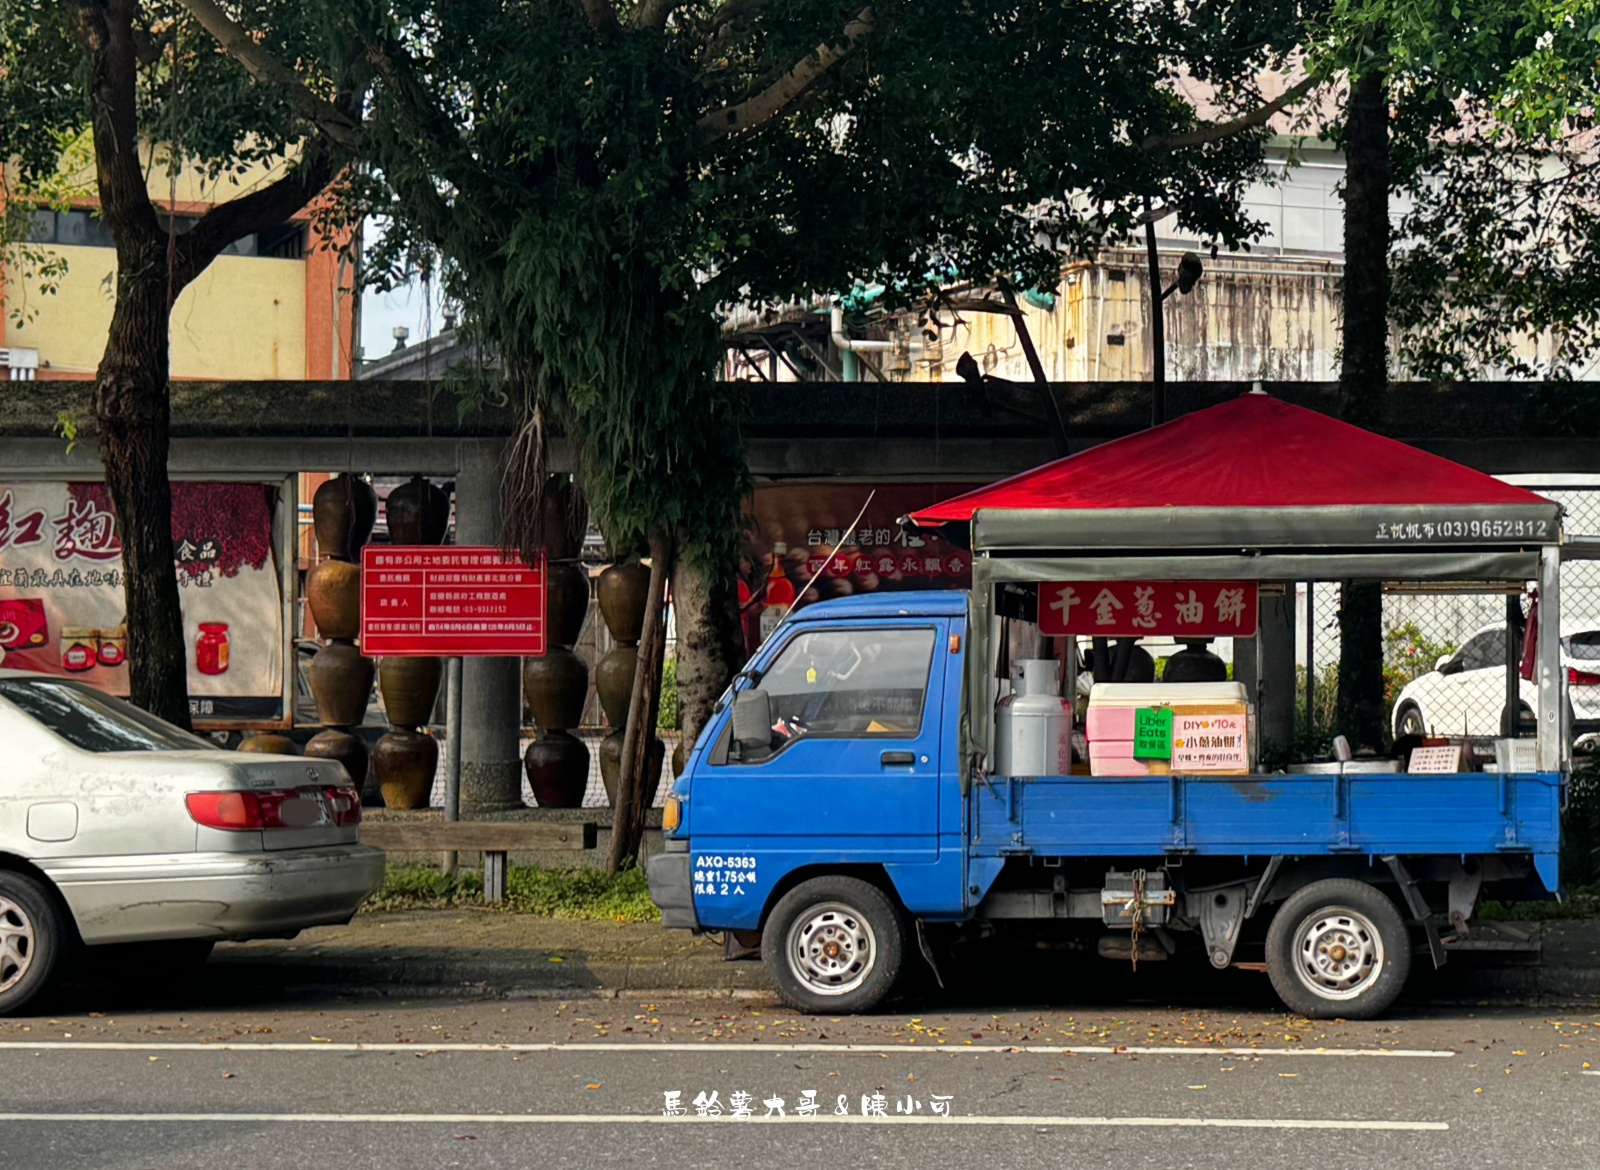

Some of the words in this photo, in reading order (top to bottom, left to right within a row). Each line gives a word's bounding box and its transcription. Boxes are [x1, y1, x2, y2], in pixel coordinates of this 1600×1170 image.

[807, 528, 891, 546] 台灣最老的
[177, 539, 217, 561] 食品
[1139, 715, 1167, 726] Uber
[1183, 721, 1202, 730] DIY
[1139, 727, 1167, 738] Eats
[696, 856, 757, 868] AXQ-5363
